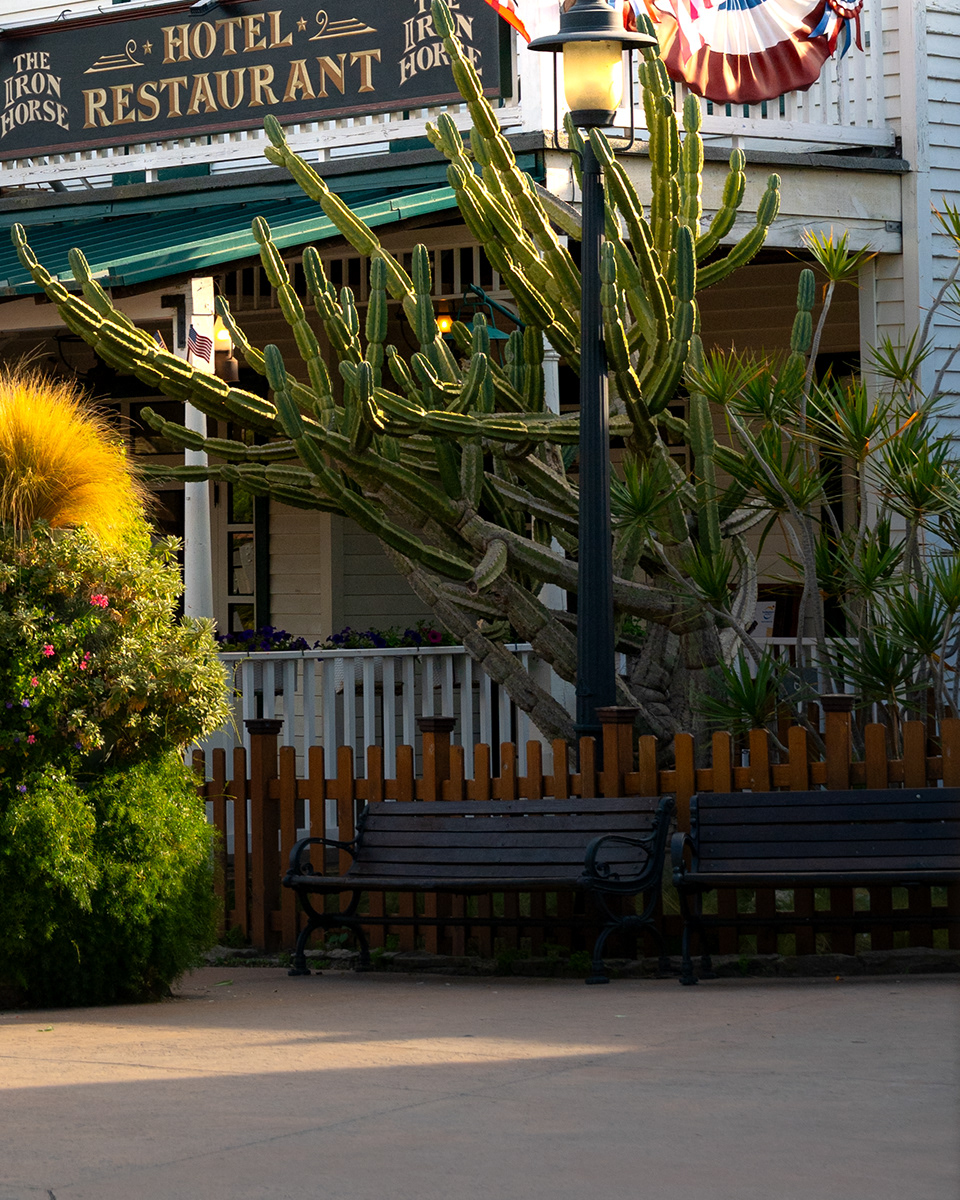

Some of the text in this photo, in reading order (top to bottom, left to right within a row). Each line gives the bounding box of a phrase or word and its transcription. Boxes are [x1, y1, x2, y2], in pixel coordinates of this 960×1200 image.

[160, 10, 293, 64] HOTEL
[402, 12, 475, 55] IRN
[13, 51, 51, 74] THE
[397, 42, 484, 89] HORE
[3, 72, 62, 109] IRON
[81, 49, 382, 129] RESTAURANT
[0, 99, 70, 139] HORSE
